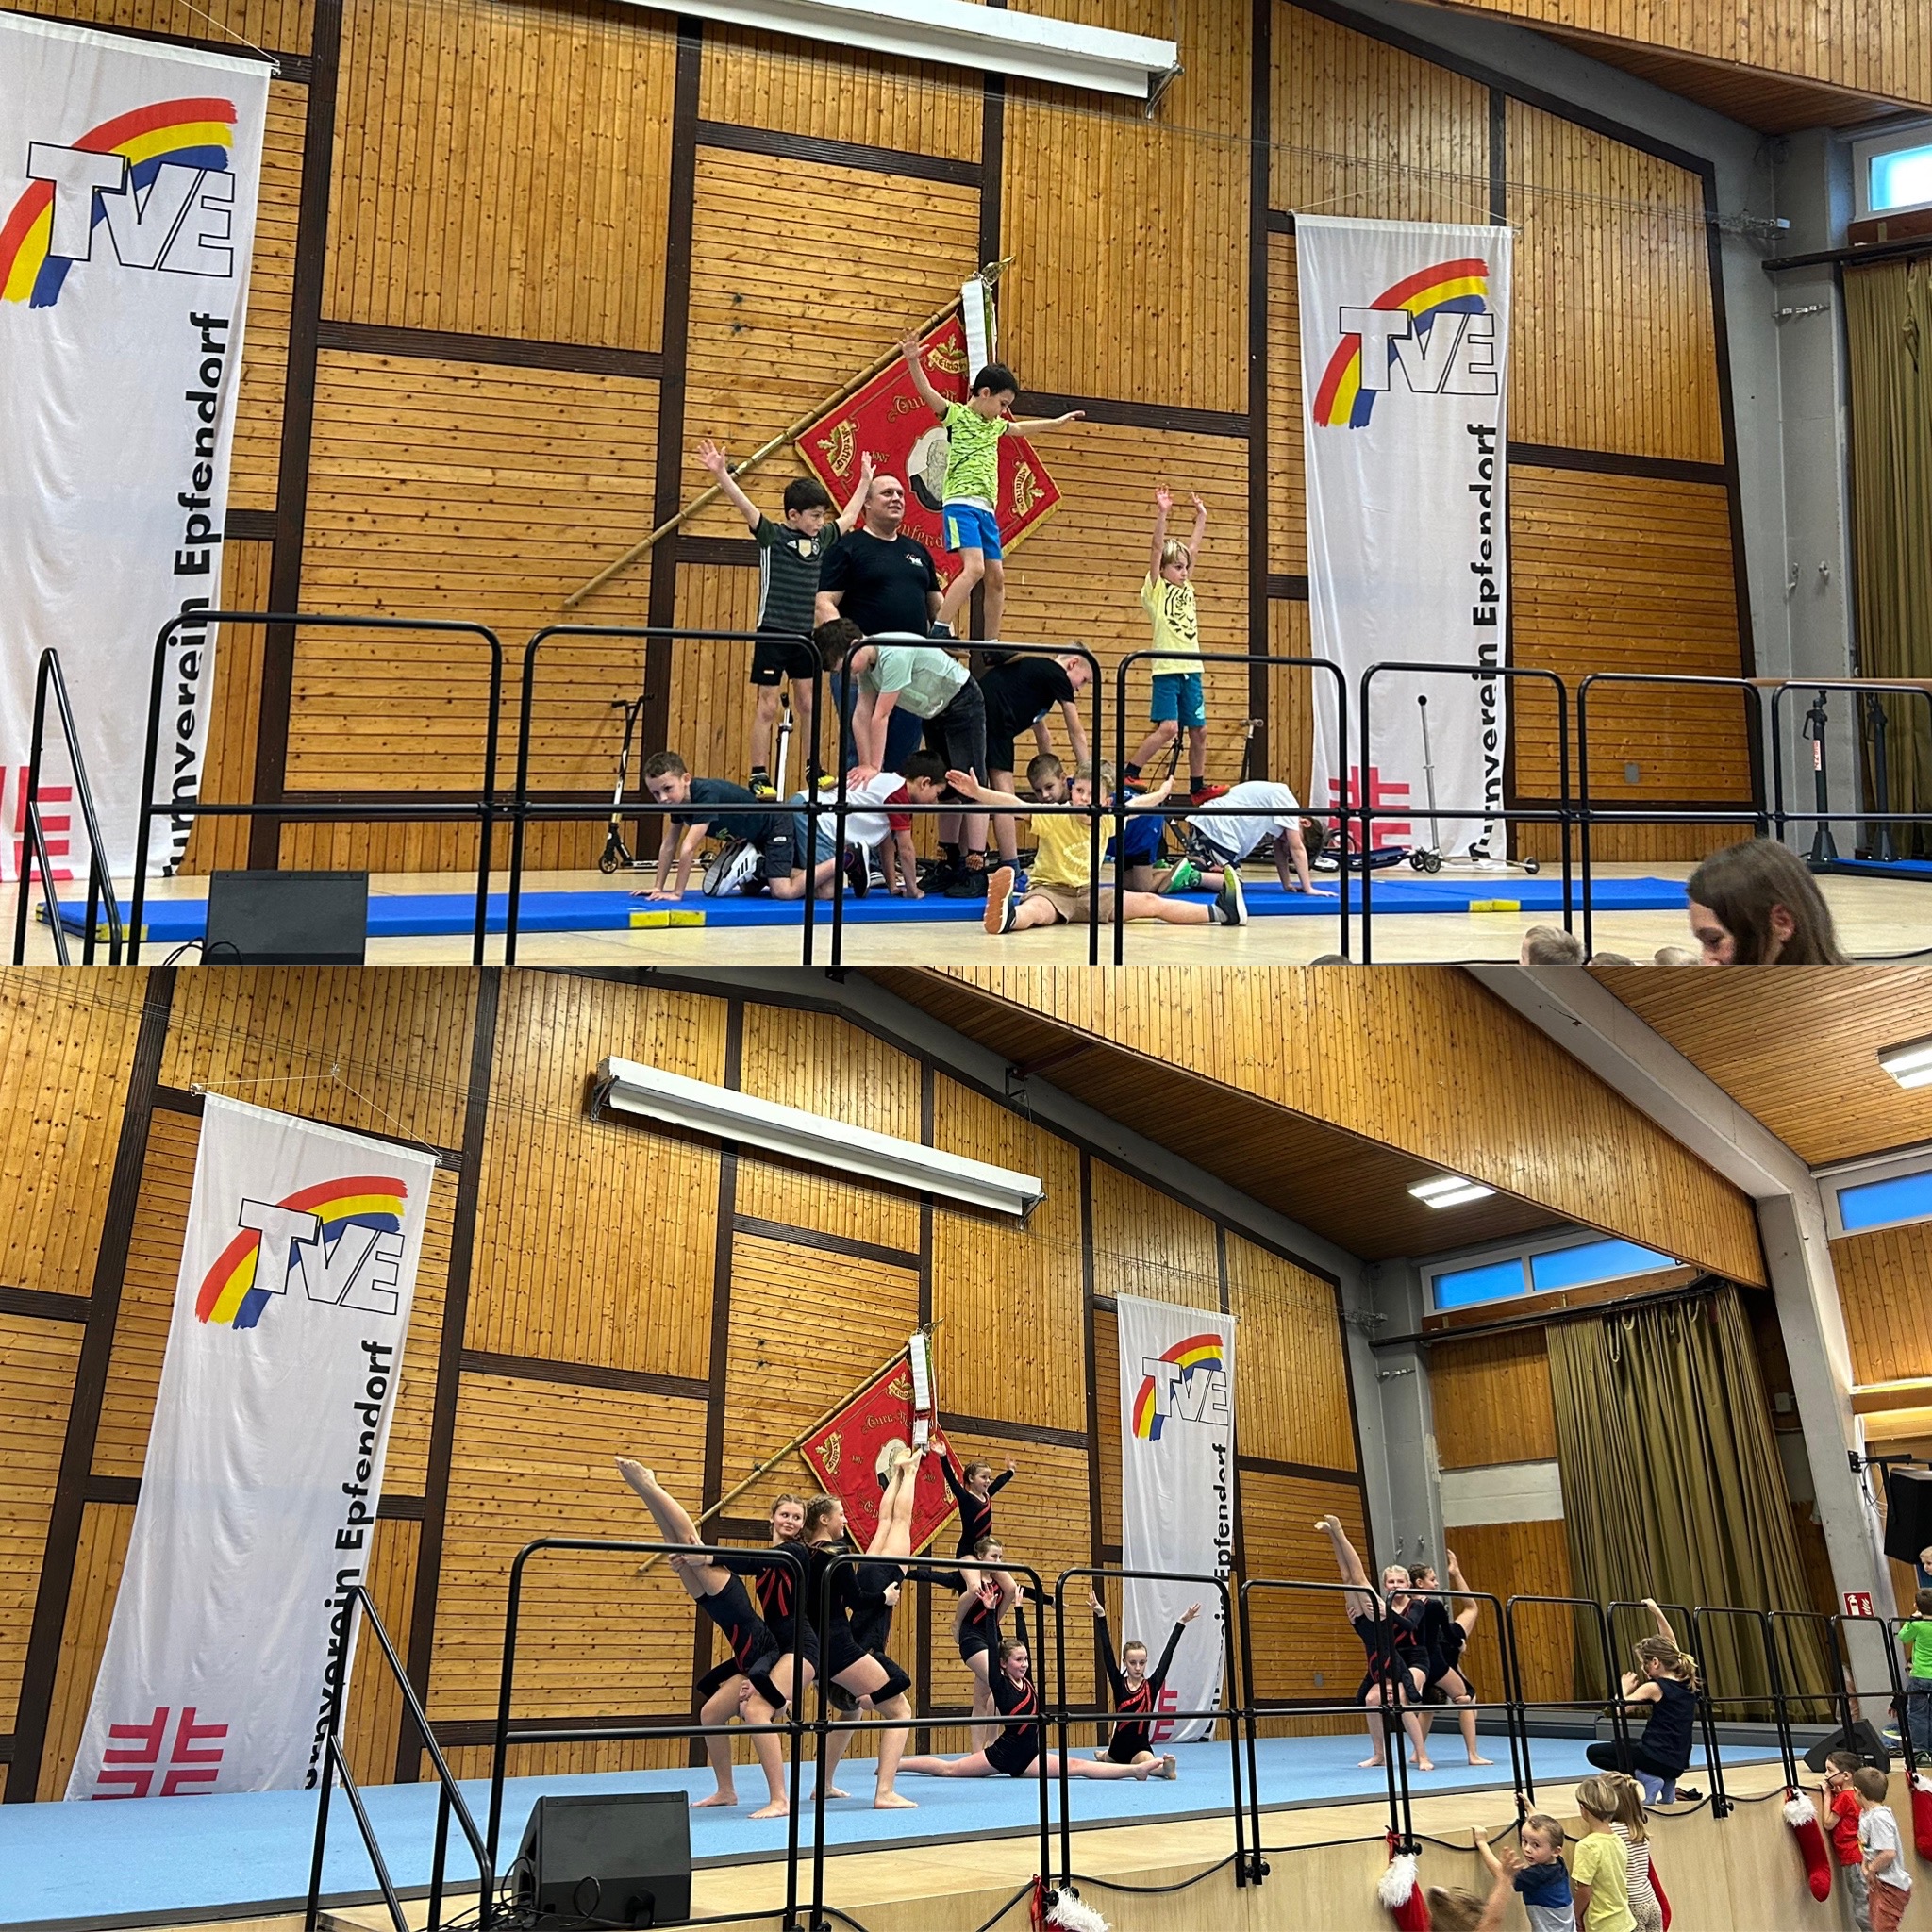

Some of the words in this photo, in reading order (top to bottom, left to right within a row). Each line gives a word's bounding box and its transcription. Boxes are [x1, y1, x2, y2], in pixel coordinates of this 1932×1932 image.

[26, 141, 235, 277] TVE
[1339, 306, 1498, 395] TVE
[175, 311, 229, 575] Epfendorf
[1467, 424, 1501, 626] Epfendorf
[238, 1198, 405, 1316] TVE
[335, 1340, 394, 1550] Epfendorf
[1142, 1357, 1229, 1426] TVE
